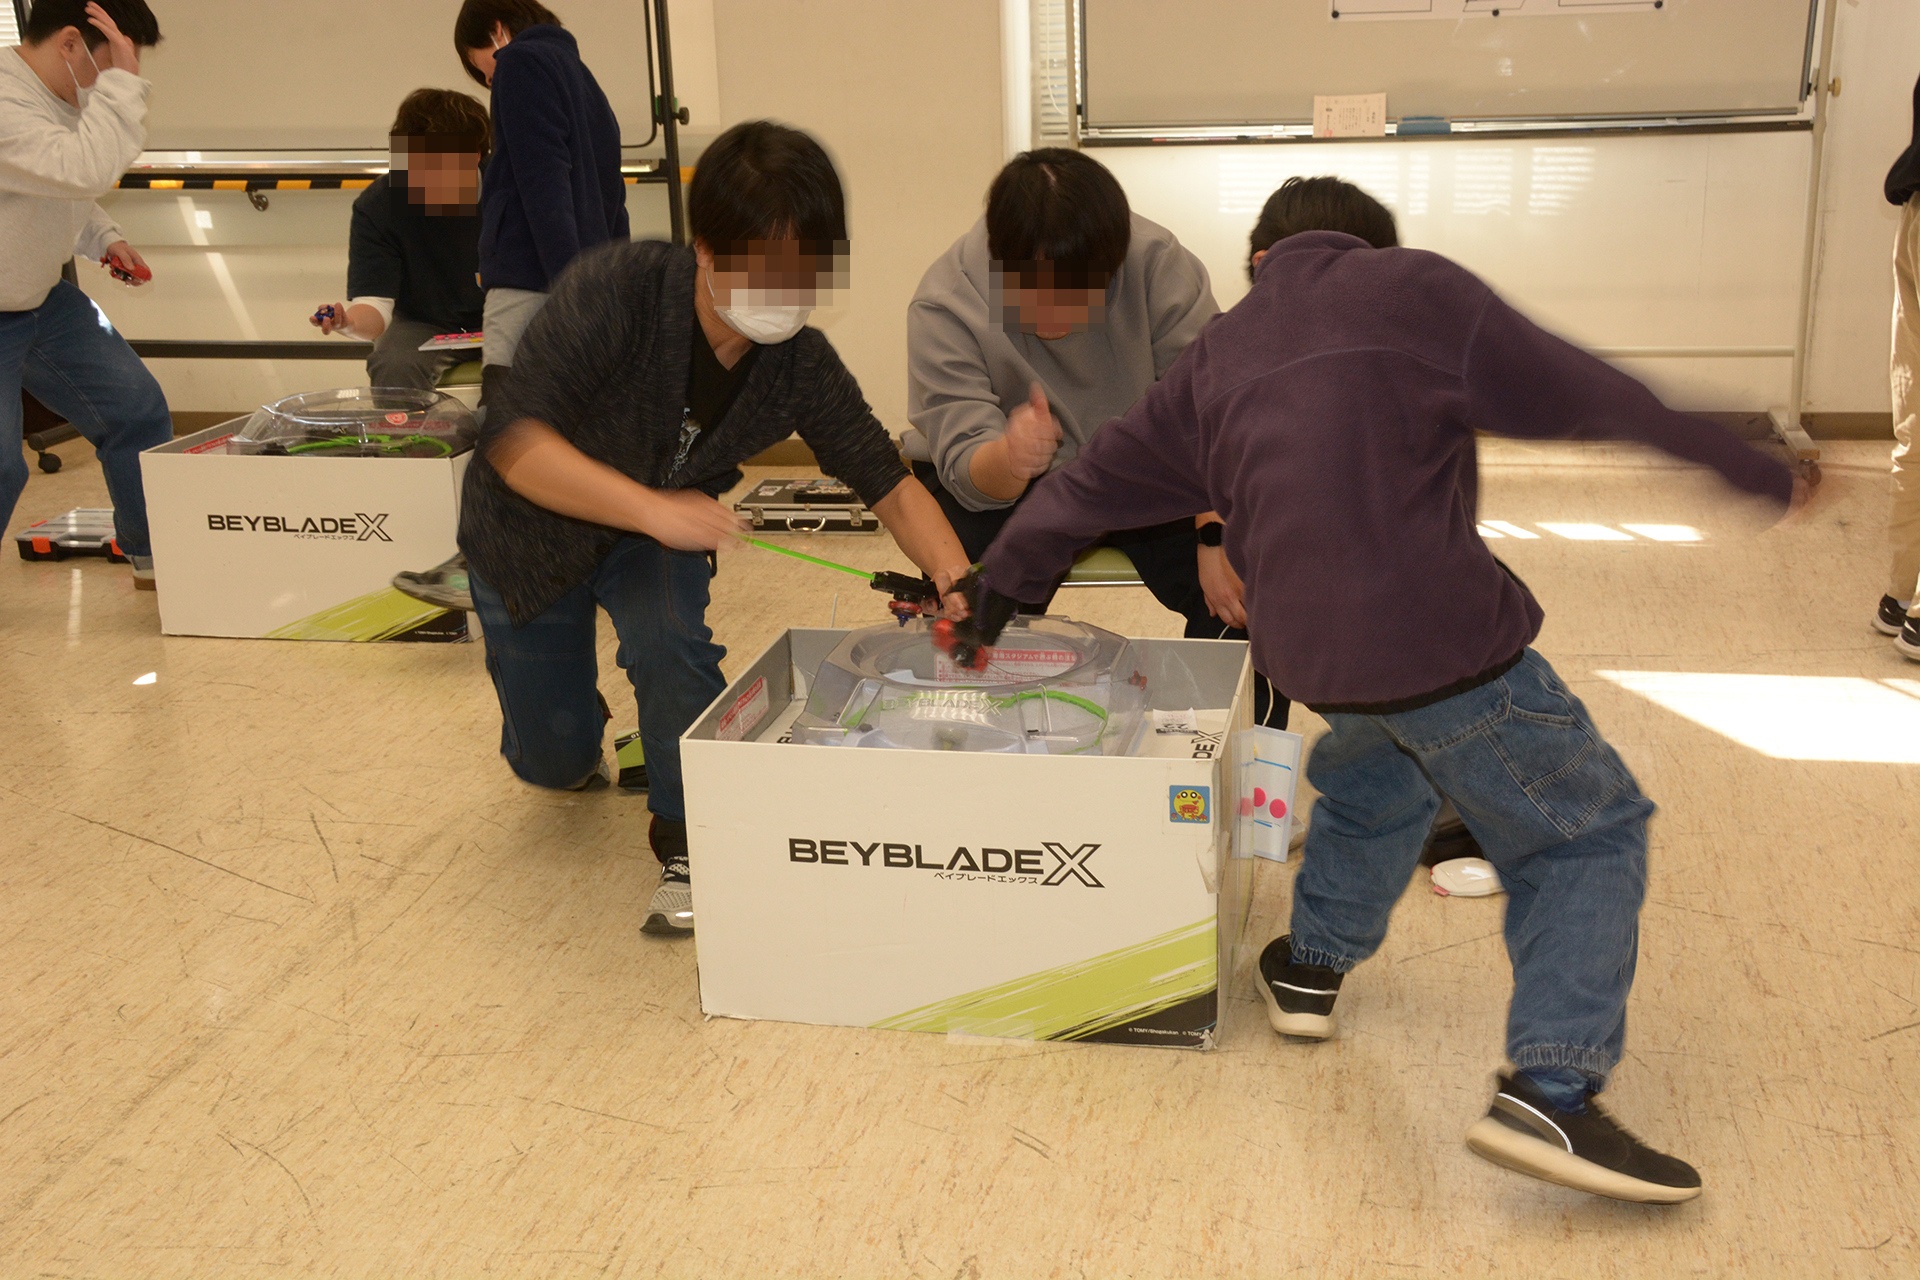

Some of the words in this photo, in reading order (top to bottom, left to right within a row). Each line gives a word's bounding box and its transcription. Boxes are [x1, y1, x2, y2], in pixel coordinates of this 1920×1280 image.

[788, 838, 1106, 888] BEYBLADEX
[934, 872, 1038, 885] ベイブレードエックス
